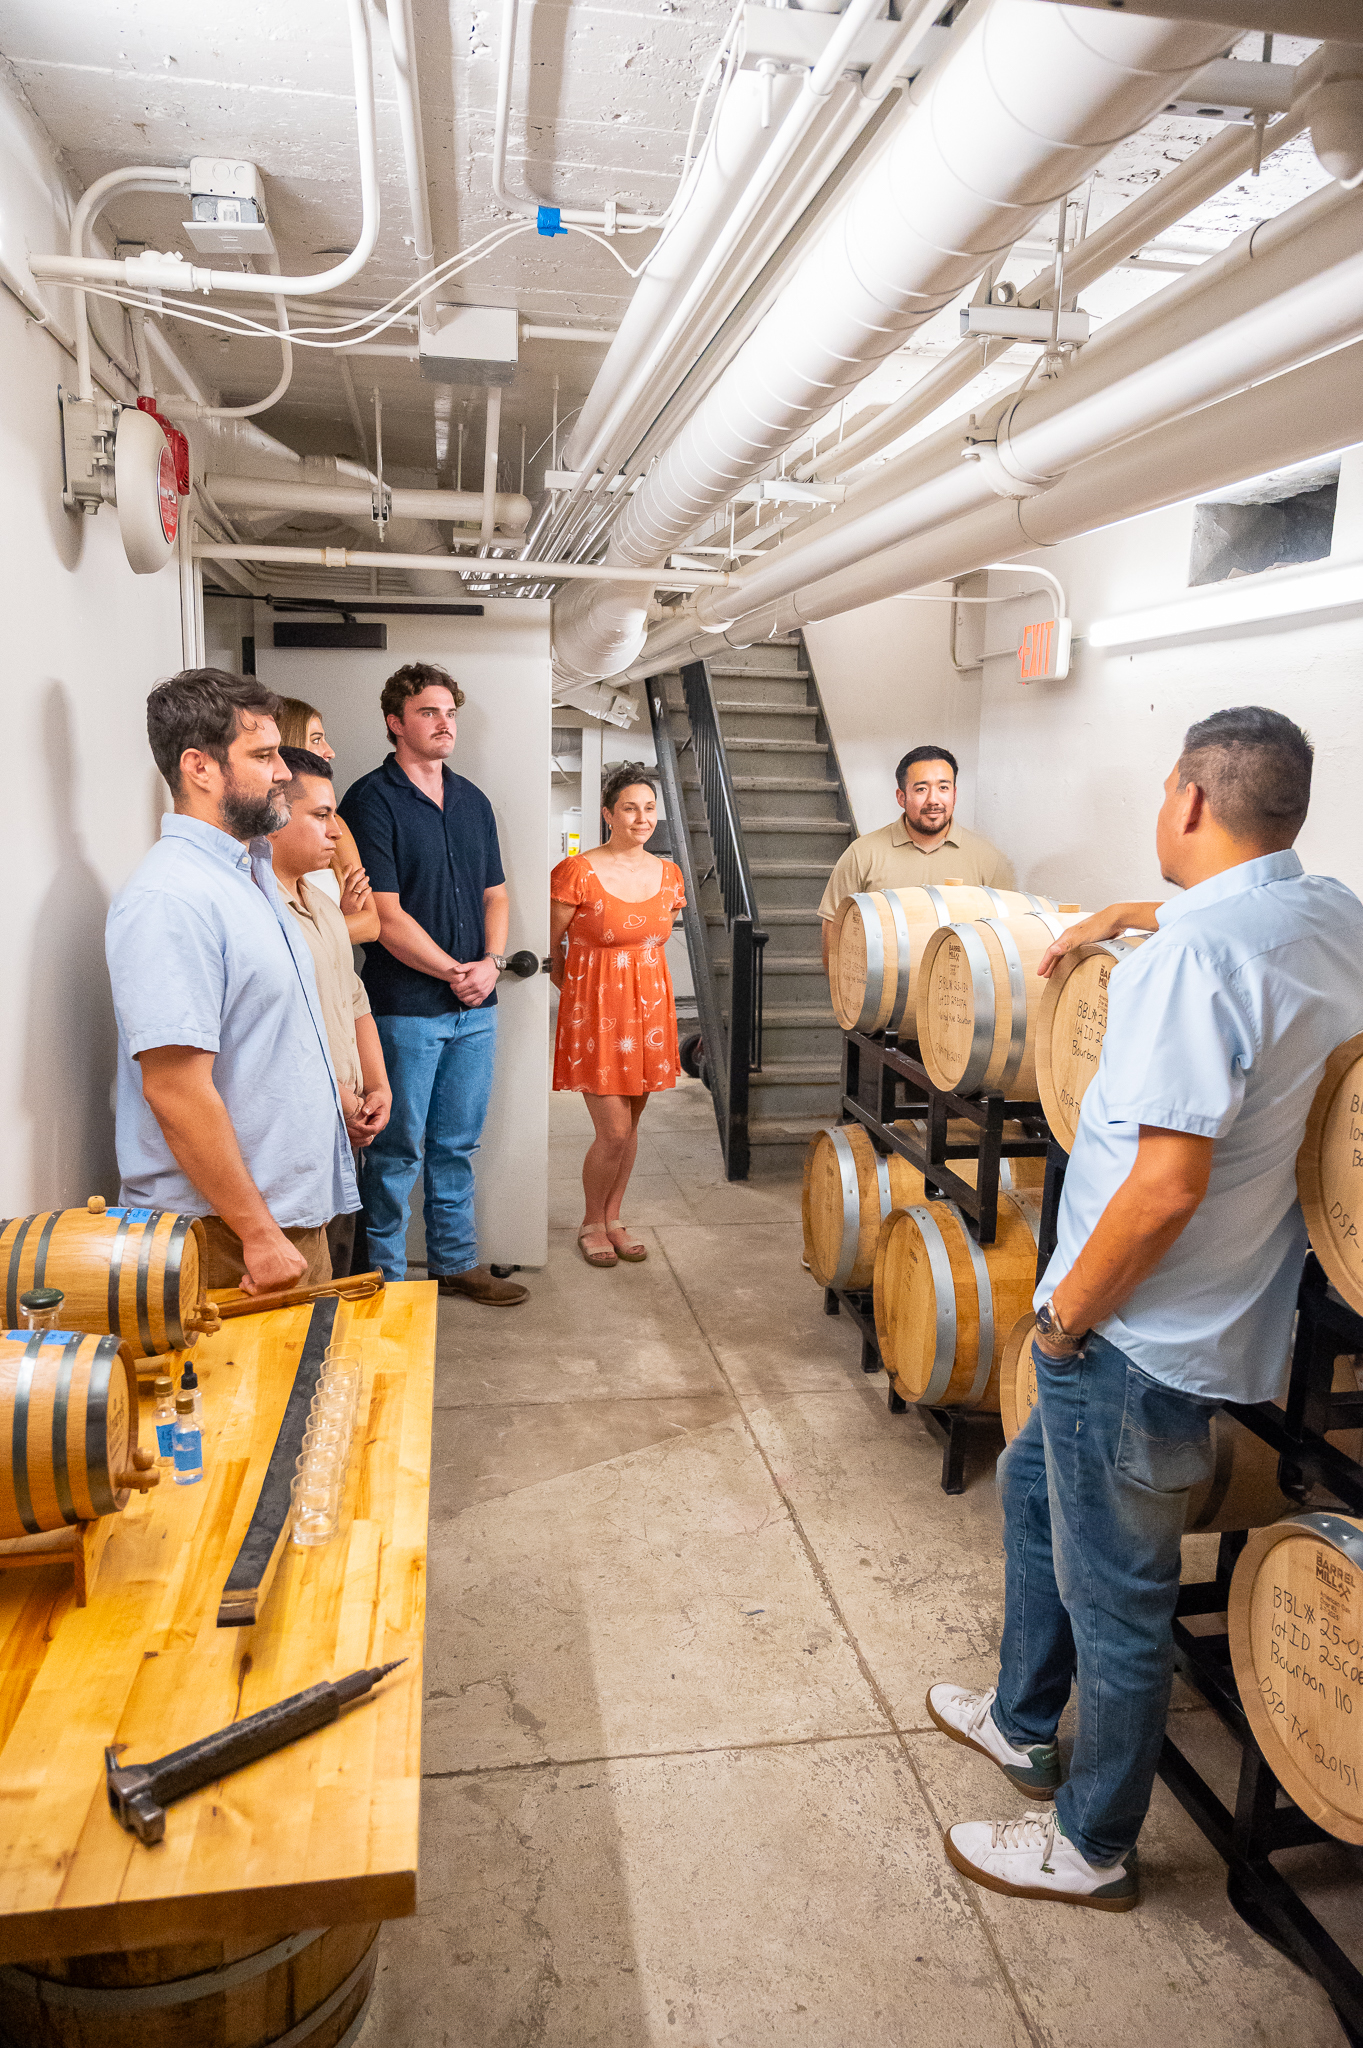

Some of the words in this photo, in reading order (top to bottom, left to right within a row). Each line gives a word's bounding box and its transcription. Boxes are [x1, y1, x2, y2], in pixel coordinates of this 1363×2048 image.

[1021, 620, 1055, 678] EXIT
[1072, 1039, 1098, 1065] Bourbon
[1316, 1554, 1356, 1589] BARREL
[1316, 1565, 1338, 1588] MILL
[1273, 1585, 1316, 1625] BBL#
[1319, 1617, 1363, 1660] 25-0
[1288, 1622, 1311, 1651] ID
[1270, 1638, 1326, 1700] Bourbon
[1334, 1685, 1353, 1714] 110
[1259, 1675, 1360, 1795] DSP-TX-20151
